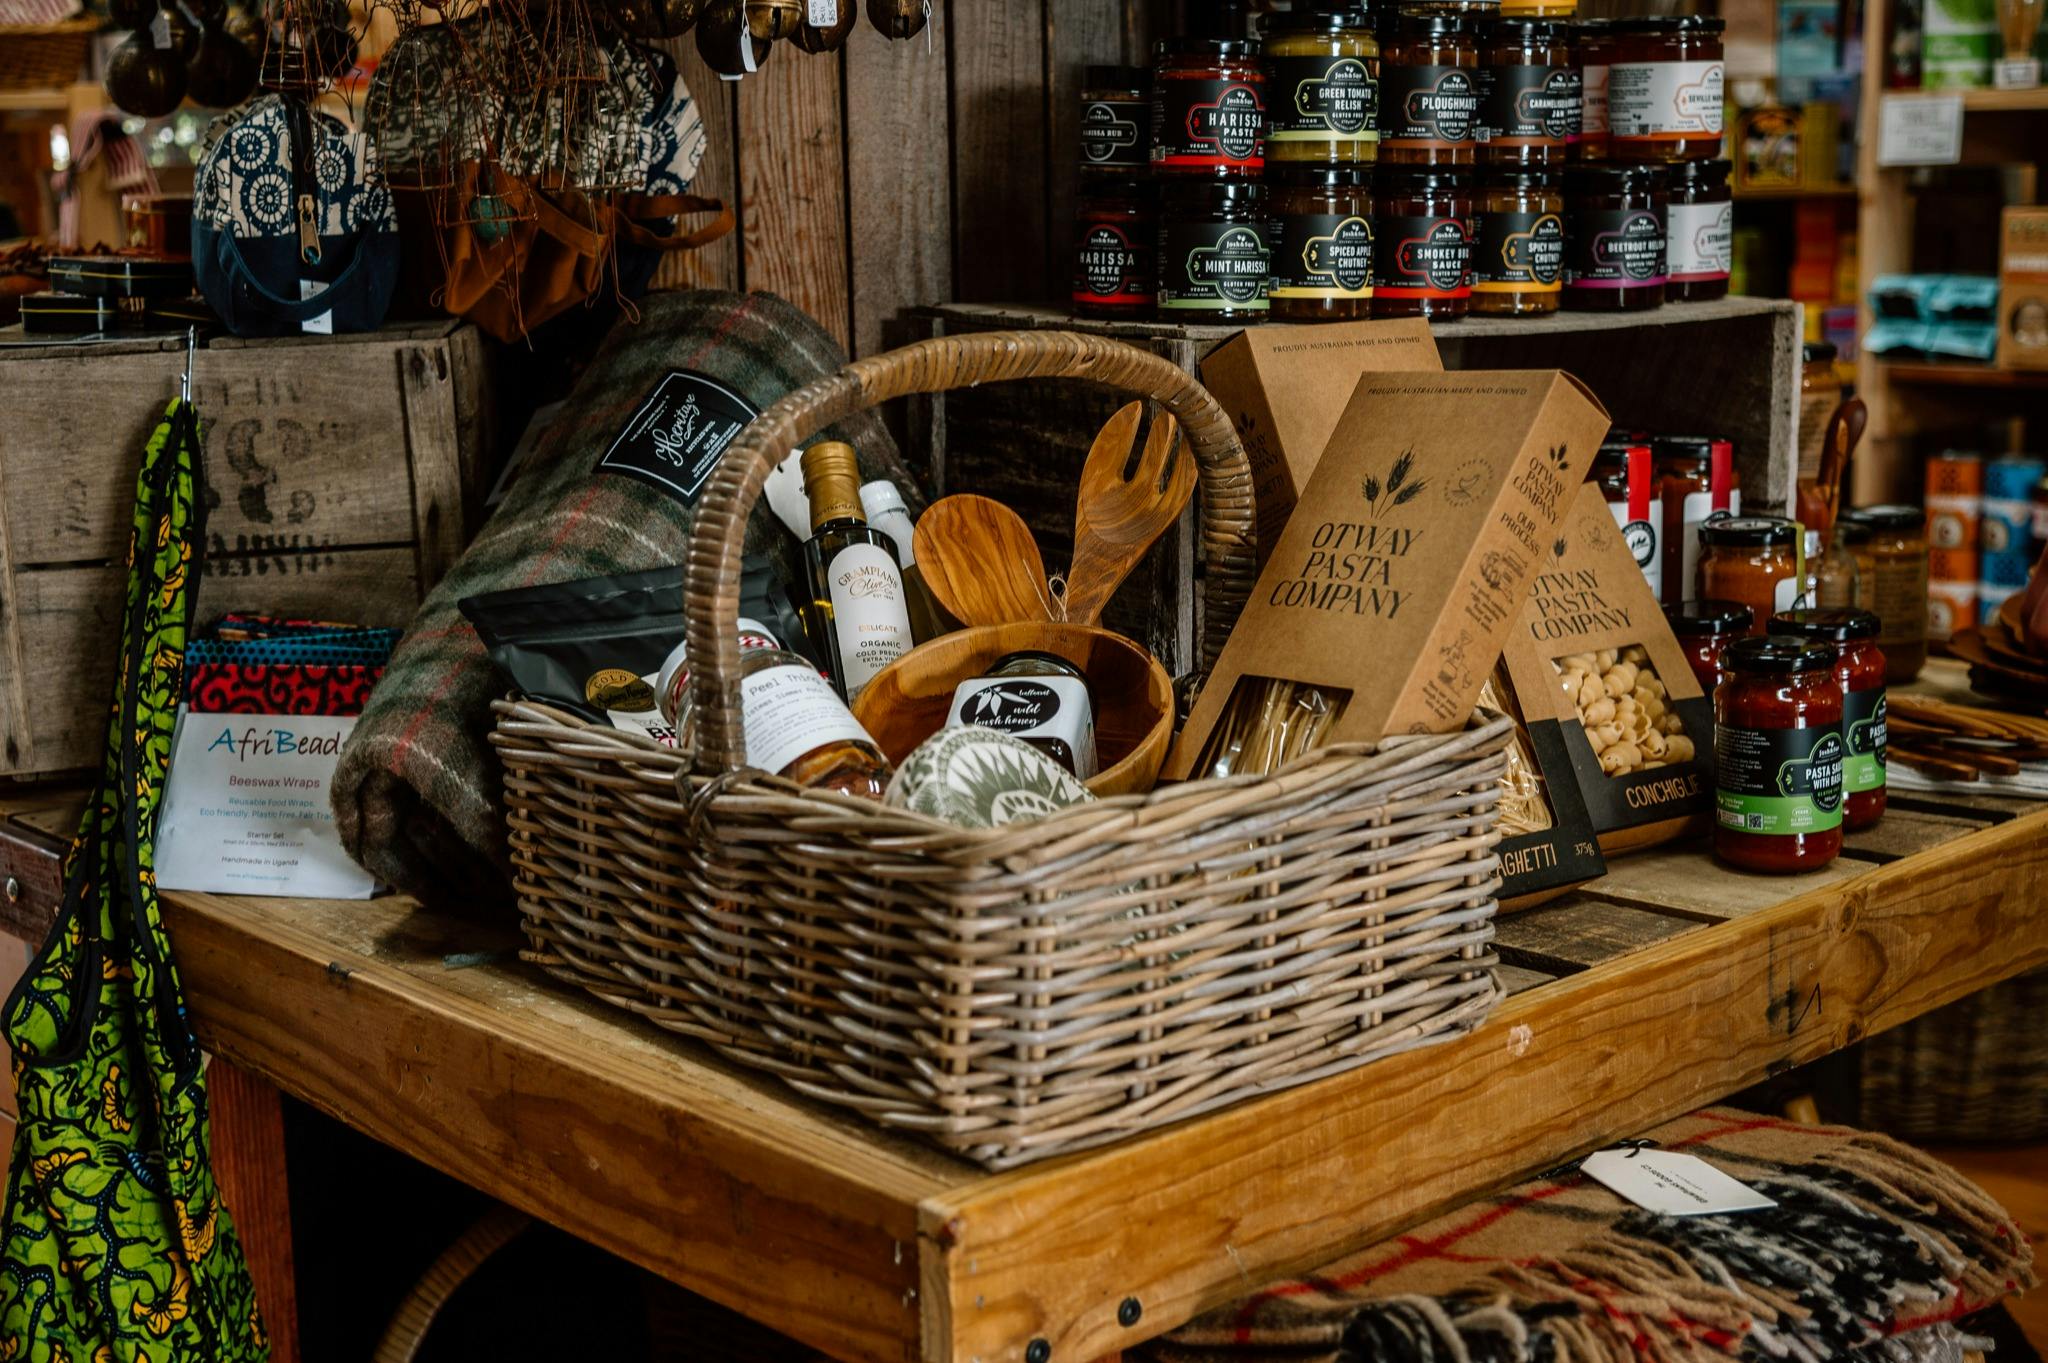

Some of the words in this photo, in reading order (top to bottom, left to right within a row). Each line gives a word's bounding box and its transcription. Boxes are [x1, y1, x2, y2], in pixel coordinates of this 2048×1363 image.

[1319, 88, 1346, 99] GREEN
[1347, 88, 1372, 100] TOMATO
[1334, 99, 1362, 111] RELISH
[1208, 112, 1262, 128] HARISSA
[1437, 110, 1454, 120] CIDER
[1107, 129, 1122, 137] RUB
[1223, 127, 1254, 137] PASTE
[1080, 251, 1134, 266] HARISSA
[1329, 246, 1355, 257] SPICED
[1356, 246, 1371, 257] APPLE
[1417, 248, 1455, 260] SMOKEY
[1088, 266, 1120, 275] PASTE
[1205, 260, 1231, 273] MINT
[1234, 260, 1266, 273] HARISSA
[1338, 258, 1367, 268] CHUTNEY
[1432, 260, 1461, 270] SAUCE
[1273, 344, 1308, 353] PROUDLY
[1310, 341, 1353, 350] AUSTRALIAN
[1355, 338, 1376, 347] MADE
[1377, 337, 1393, 345] AND
[1395, 336, 1420, 344] OWNED
[1402, 386, 1449, 395] AUSTRALIAN
[1450, 387, 1473, 395] MADE
[1476, 387, 1494, 395] AND
[1495, 387, 1528, 396] OWNED
[652, 393, 700, 467] Heritage
[1529, 456, 1566, 497] OTWAY
[1525, 470, 1556, 508] PASTA
[1512, 475, 1560, 525] COMPANY
[1517, 511, 1537, 536] OUR
[1312, 522, 1424, 557] OTWAY
[1500, 512, 1541, 557] PROCESS
[1300, 551, 1390, 586] PASTA
[838, 565, 898, 588] GRAMPIANS
[850, 578, 884, 598] Olive
[1269, 580, 1413, 620] COMPANY
[1536, 591, 1608, 618] PASTA
[858, 624, 897, 632] DELICATE
[1530, 607, 1632, 641] COMPANY
[860, 640, 901, 649] ORGANIC
[856, 650, 877, 658] COLD
[594, 674, 627, 689] GOLD
[749, 678, 780, 697] Peel
[1013, 702, 1041, 714] wild
[974, 716, 1003, 727] bush
[1004, 715, 1037, 728] honey
[208, 728, 341, 763] AfriBead
[1806, 765, 1831, 780] PASTA
[229, 775, 281, 788] Beeswax
[283, 776, 320, 790] Wraps
[1813, 777, 1831, 790] WITH
[229, 797, 266, 806] Reusable
[268, 798, 286, 806] Food
[200, 807, 215, 817] Eco
[252, 810, 278, 818] Plastic
[299, 811, 314, 820] Fair
[316, 812, 334, 821] Tra
[247, 831, 272, 839] Starter
[1573, 842, 1595, 857] 375g
[222, 855, 262, 865] Handmade
[272, 857, 299, 867] Uganda
[1495, 842, 1558, 877] AGHETTI
